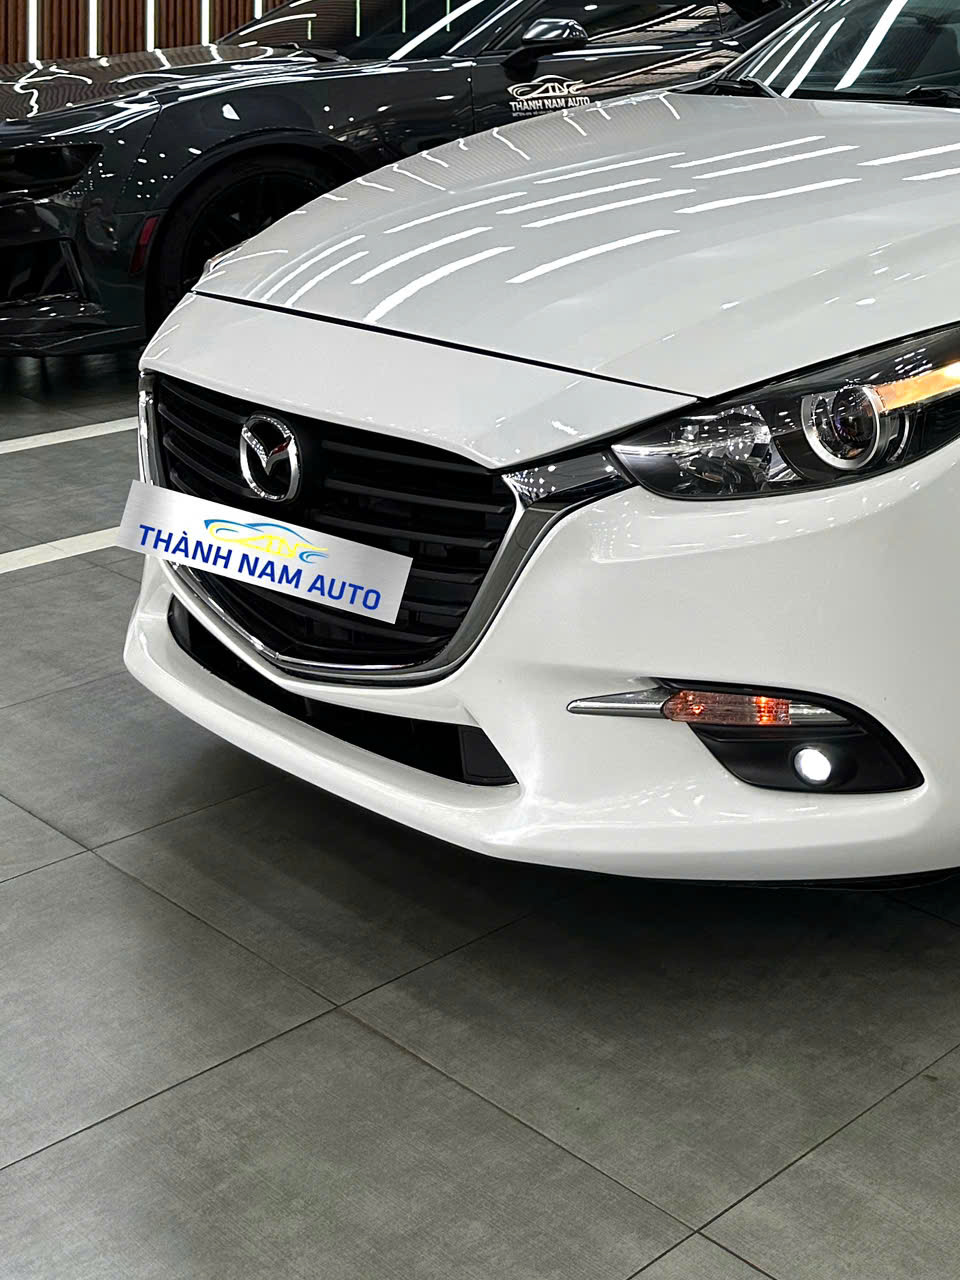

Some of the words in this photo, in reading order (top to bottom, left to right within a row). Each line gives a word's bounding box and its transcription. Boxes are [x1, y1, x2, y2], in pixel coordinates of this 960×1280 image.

[545, 97, 566, 109] NAM
[567, 96, 591, 108] AUTO
[138, 524, 232, 570] THÀNH
[238, 552, 303, 590] NAM
[307, 574, 382, 611] AUTO
